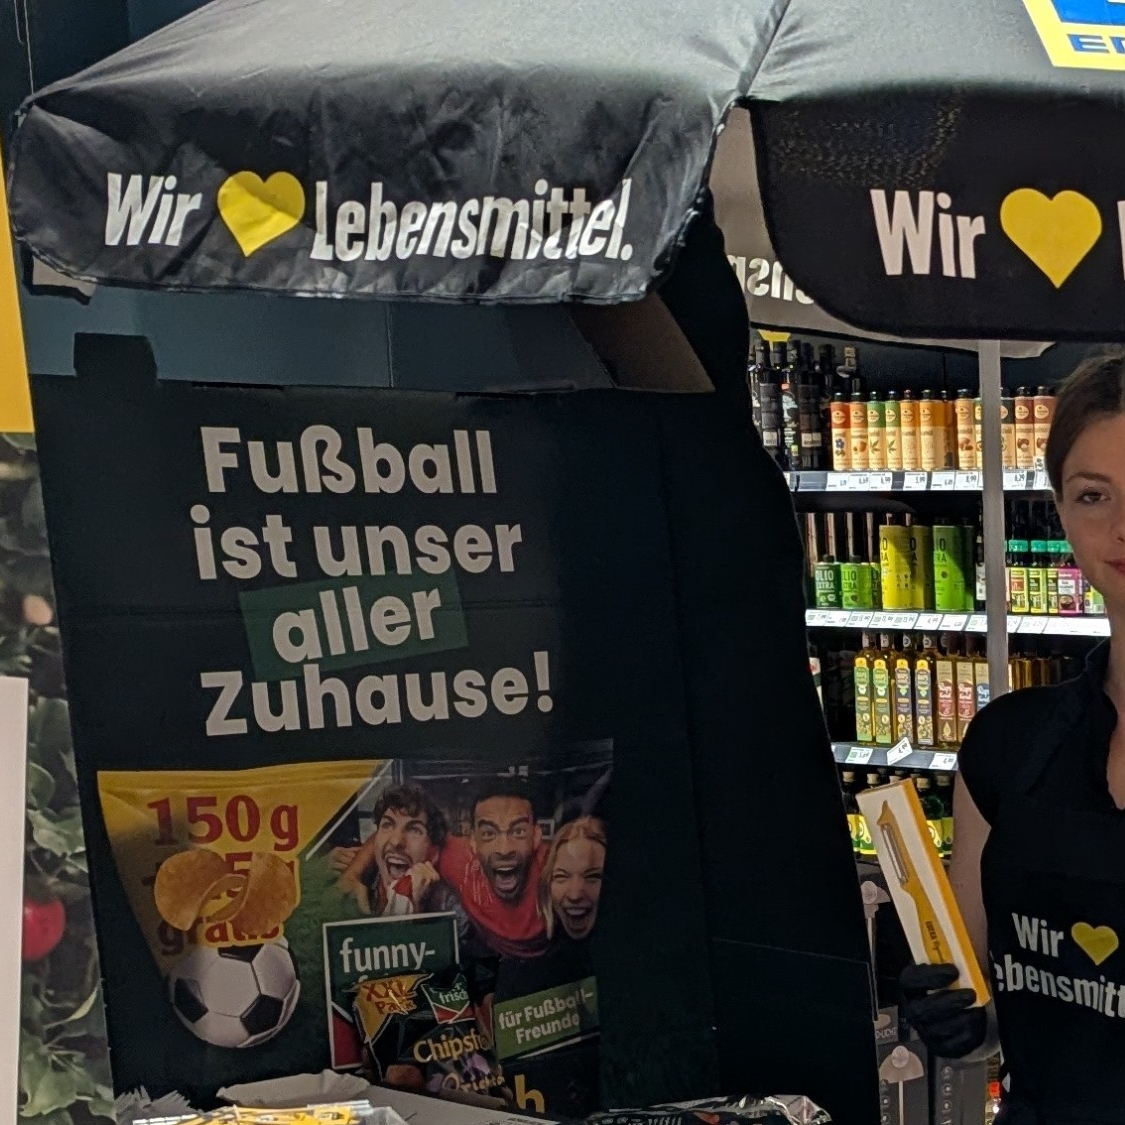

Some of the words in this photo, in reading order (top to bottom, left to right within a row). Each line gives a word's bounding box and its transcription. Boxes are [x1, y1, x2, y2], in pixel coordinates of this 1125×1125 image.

[104, 172, 202, 247] Wir
[309, 178, 634, 262] Lebensmittel.
[870, 189, 987, 280] Wir
[200, 424, 498, 495] Fußball
[190, 504, 298, 581] ist
[313, 522, 523, 577] unser
[271, 585, 442, 664] aller
[200, 650, 554, 737] Zuhause!
[147, 794, 261, 845] 150
[270, 803, 300, 852] g
[339, 936, 436, 974] funny-
[1011, 912, 1065, 959] Wir
[515, 1012, 582, 1045] Freunde
[524, 987, 596, 1022] Fußball-
